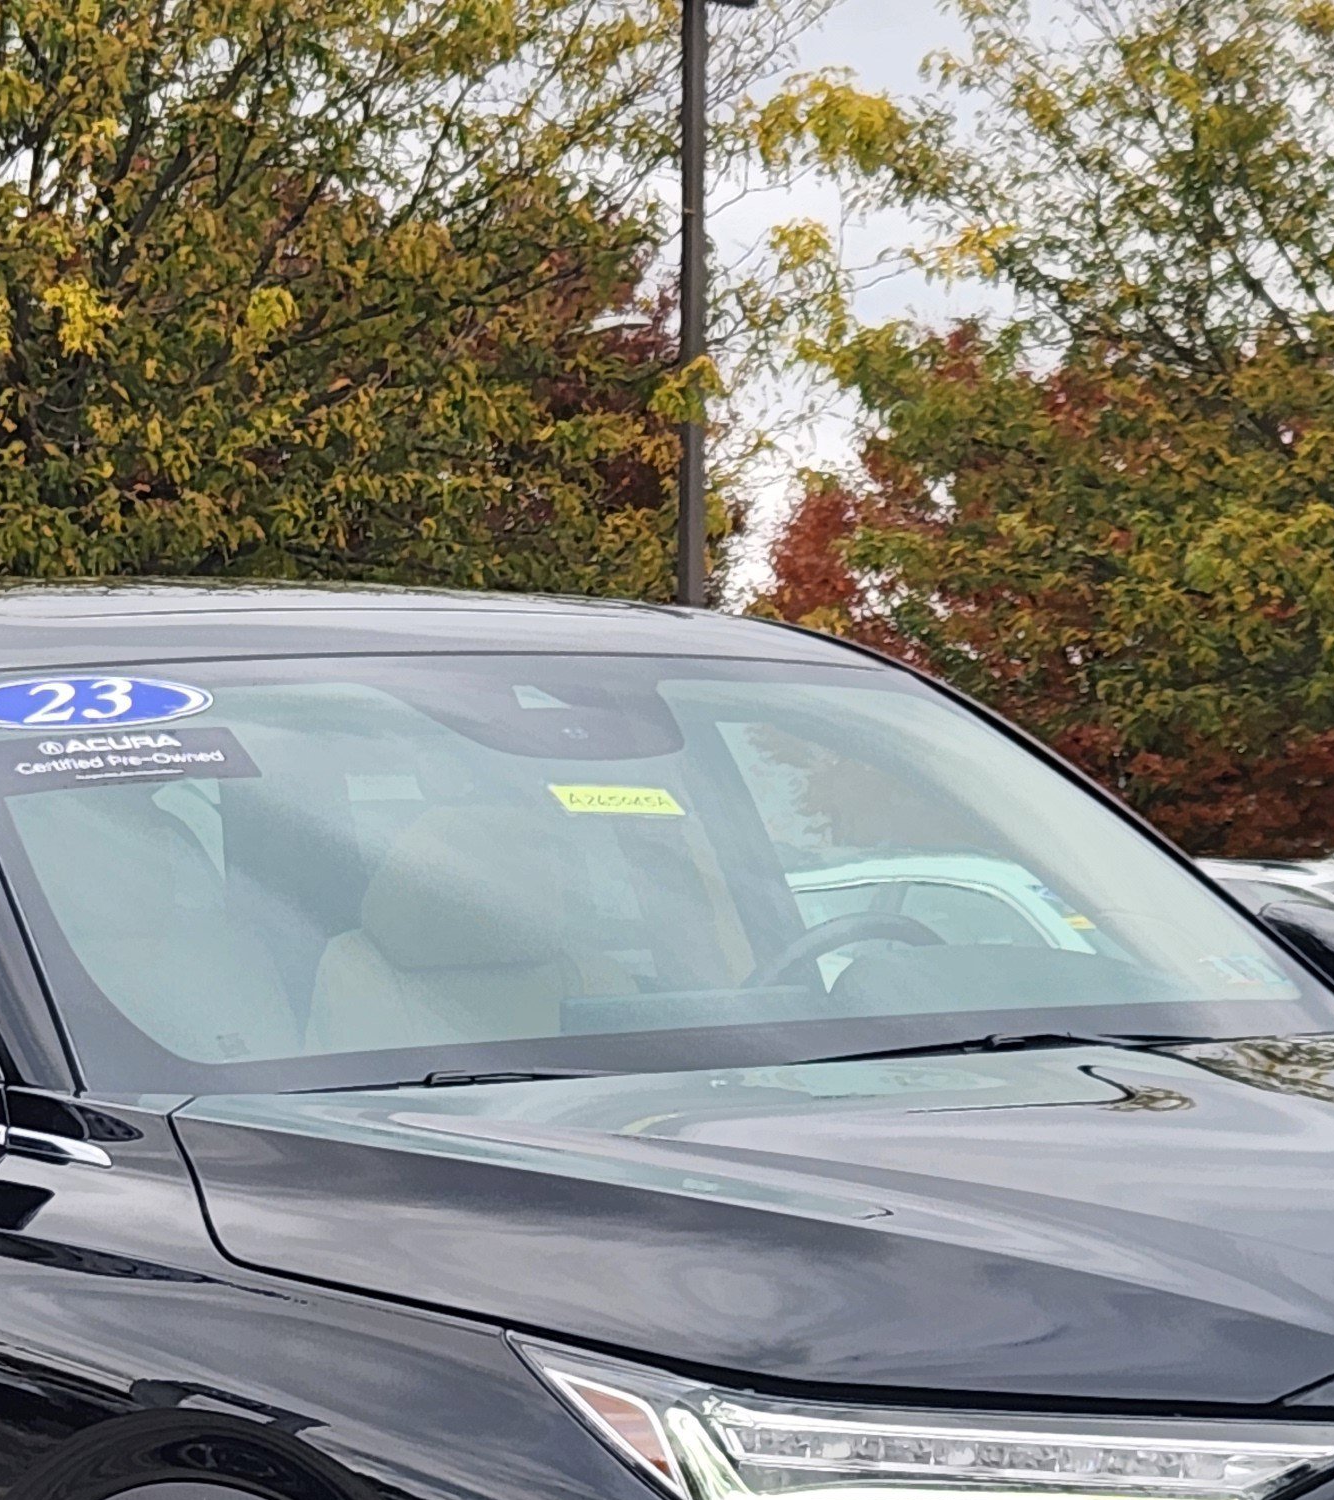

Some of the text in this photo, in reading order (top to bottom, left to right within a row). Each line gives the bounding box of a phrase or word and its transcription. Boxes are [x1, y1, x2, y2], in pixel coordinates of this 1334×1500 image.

[22, 678, 134, 724] 23
[64, 733, 182, 754] ACURA
[14, 754, 105, 775] Certified
[107, 749, 226, 767] Pre-Owned
